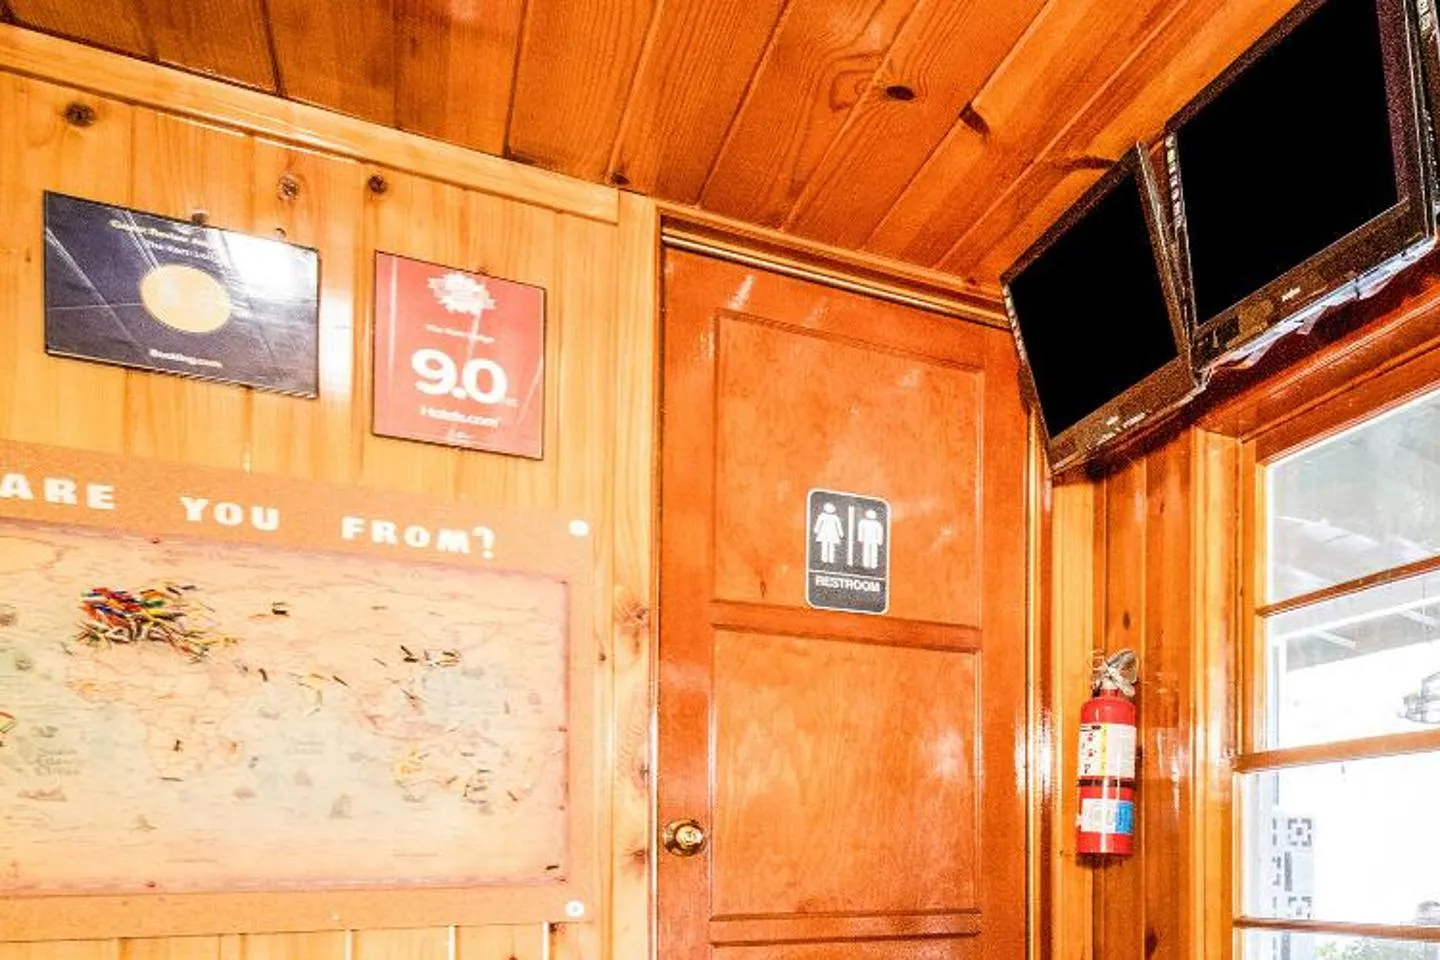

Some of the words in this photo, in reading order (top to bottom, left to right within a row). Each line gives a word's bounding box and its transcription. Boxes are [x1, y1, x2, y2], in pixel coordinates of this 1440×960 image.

[411, 347, 508, 405] 9.0
[0, 473, 116, 509] ARE
[180, 496, 280, 531] YOU
[341, 516, 495, 559] FROM?
[814, 575, 881, 592] RESTROOM
